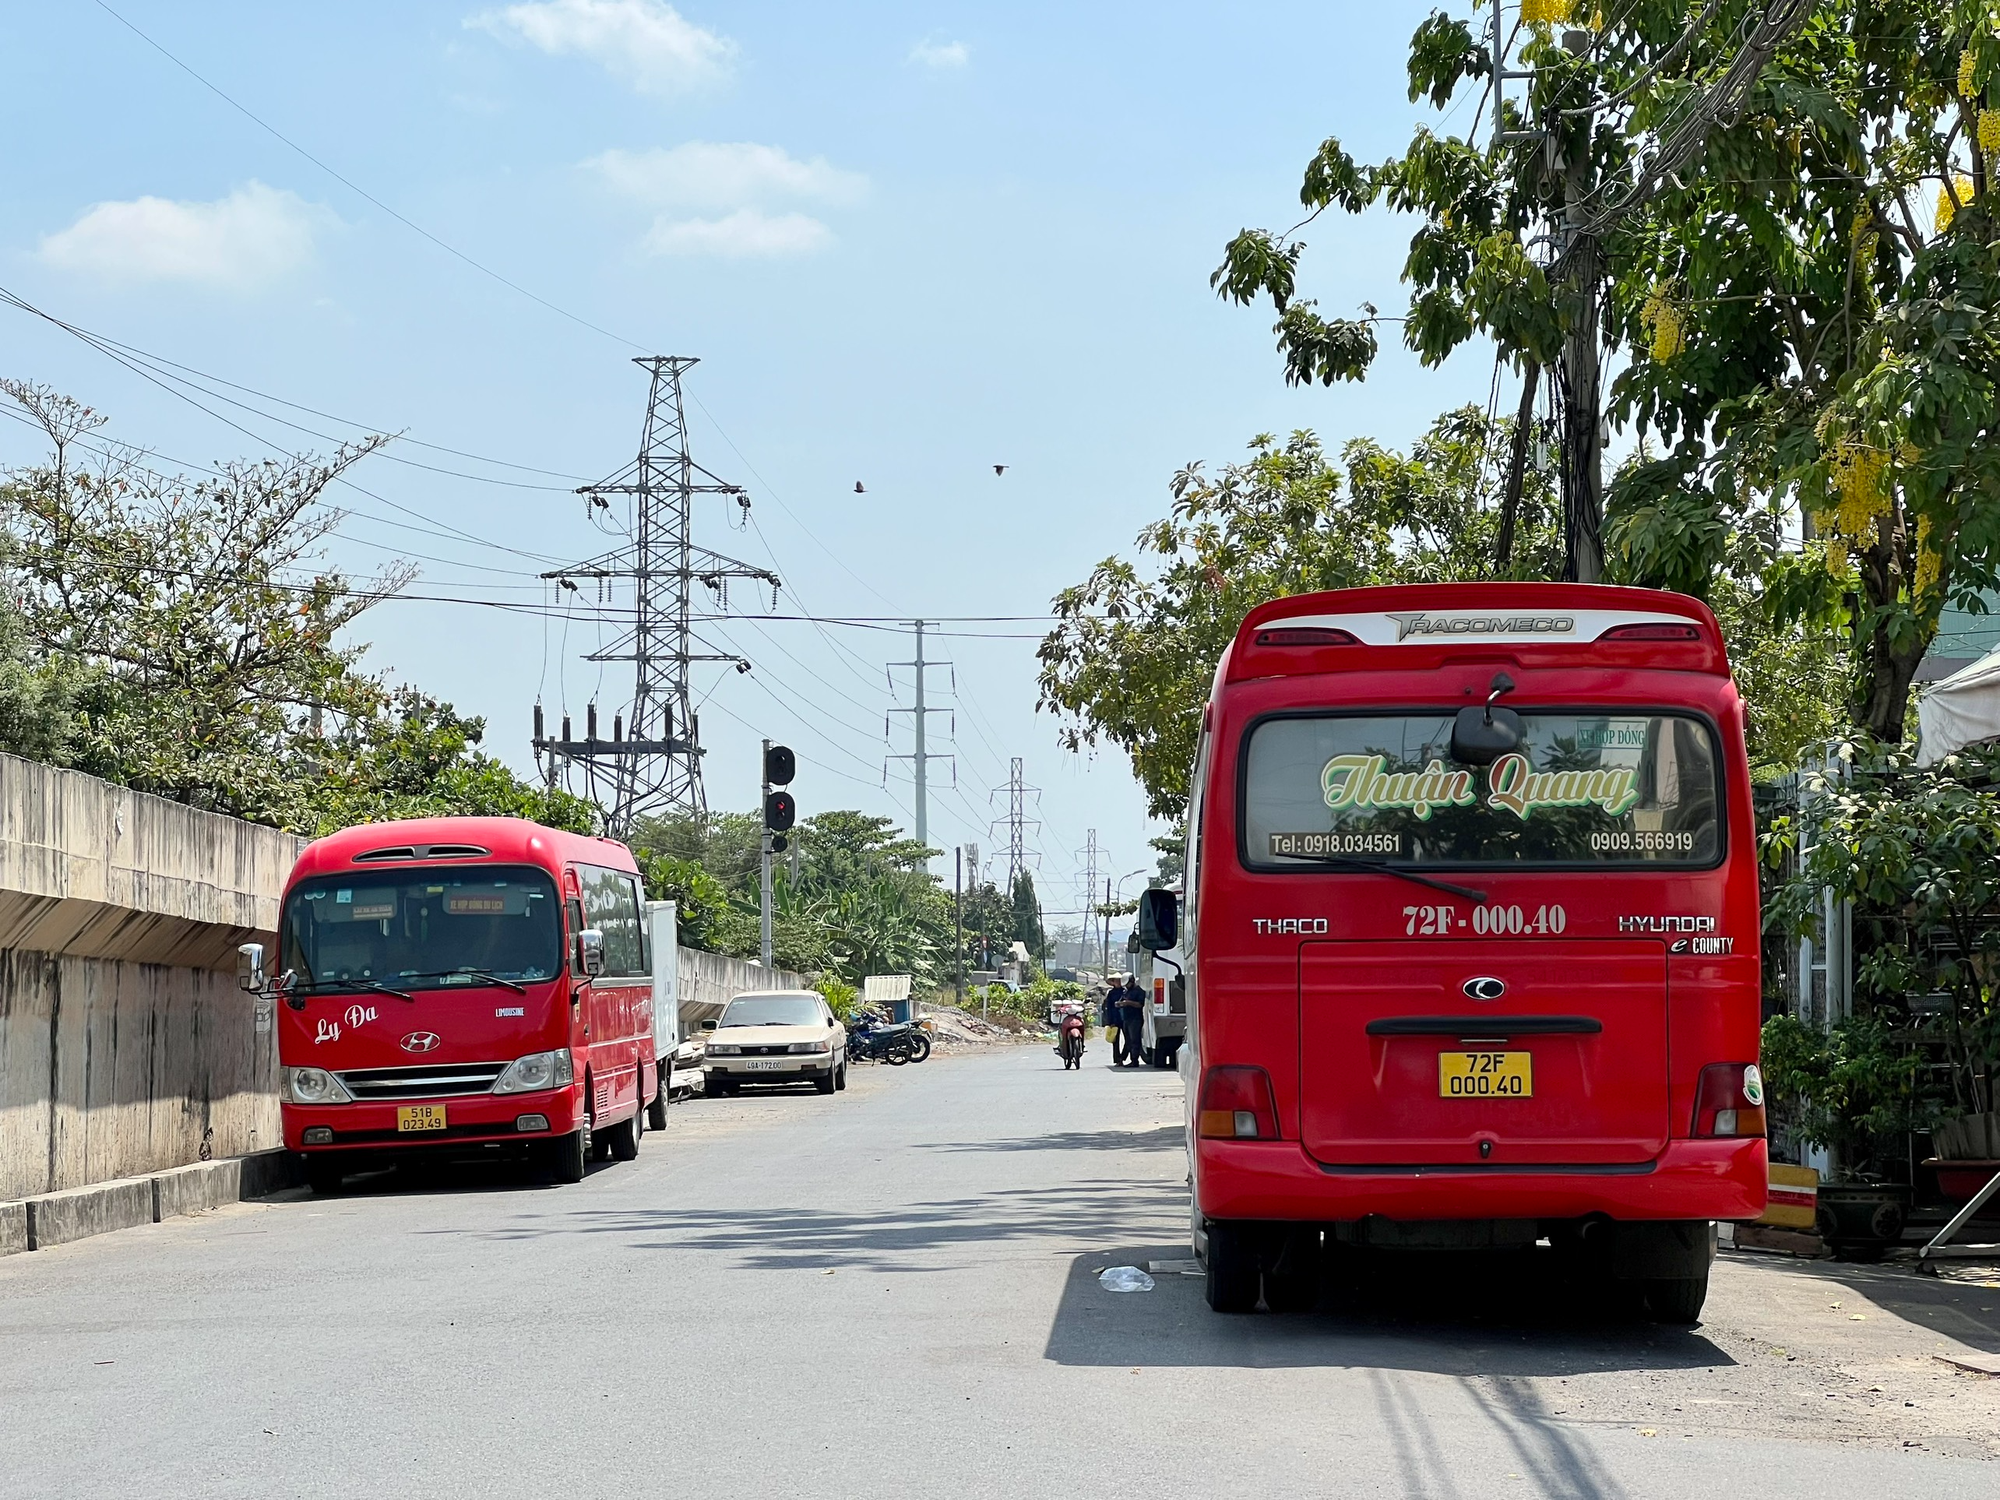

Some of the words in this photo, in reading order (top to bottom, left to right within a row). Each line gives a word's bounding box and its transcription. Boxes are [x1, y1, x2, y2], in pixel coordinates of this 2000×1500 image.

[1385, 613, 1574, 642] TRACOMECO
[1617, 724, 1646, 744] ĐỒNG
[1320, 753, 1477, 822] Thuận
[1487, 752, 1641, 822] Quang
[1271, 835, 1301, 853] Tel:
[1304, 834, 1400, 853] 0918.034561
[1591, 832, 1693, 850] 0909.566919
[1252, 918, 1328, 934] THACO
[1618, 916, 1715, 932] HYUNDAI
[1692, 937, 1734, 954] COUNTY
[314, 1018, 342, 1045] Ly
[344, 1004, 379, 1029] Đa
[1466, 1054, 1505, 1073] 72F
[1450, 1075, 1522, 1095] 000.40
[411, 1107, 432, 1118] 51B
[403, 1118, 441, 1130] 023.49
